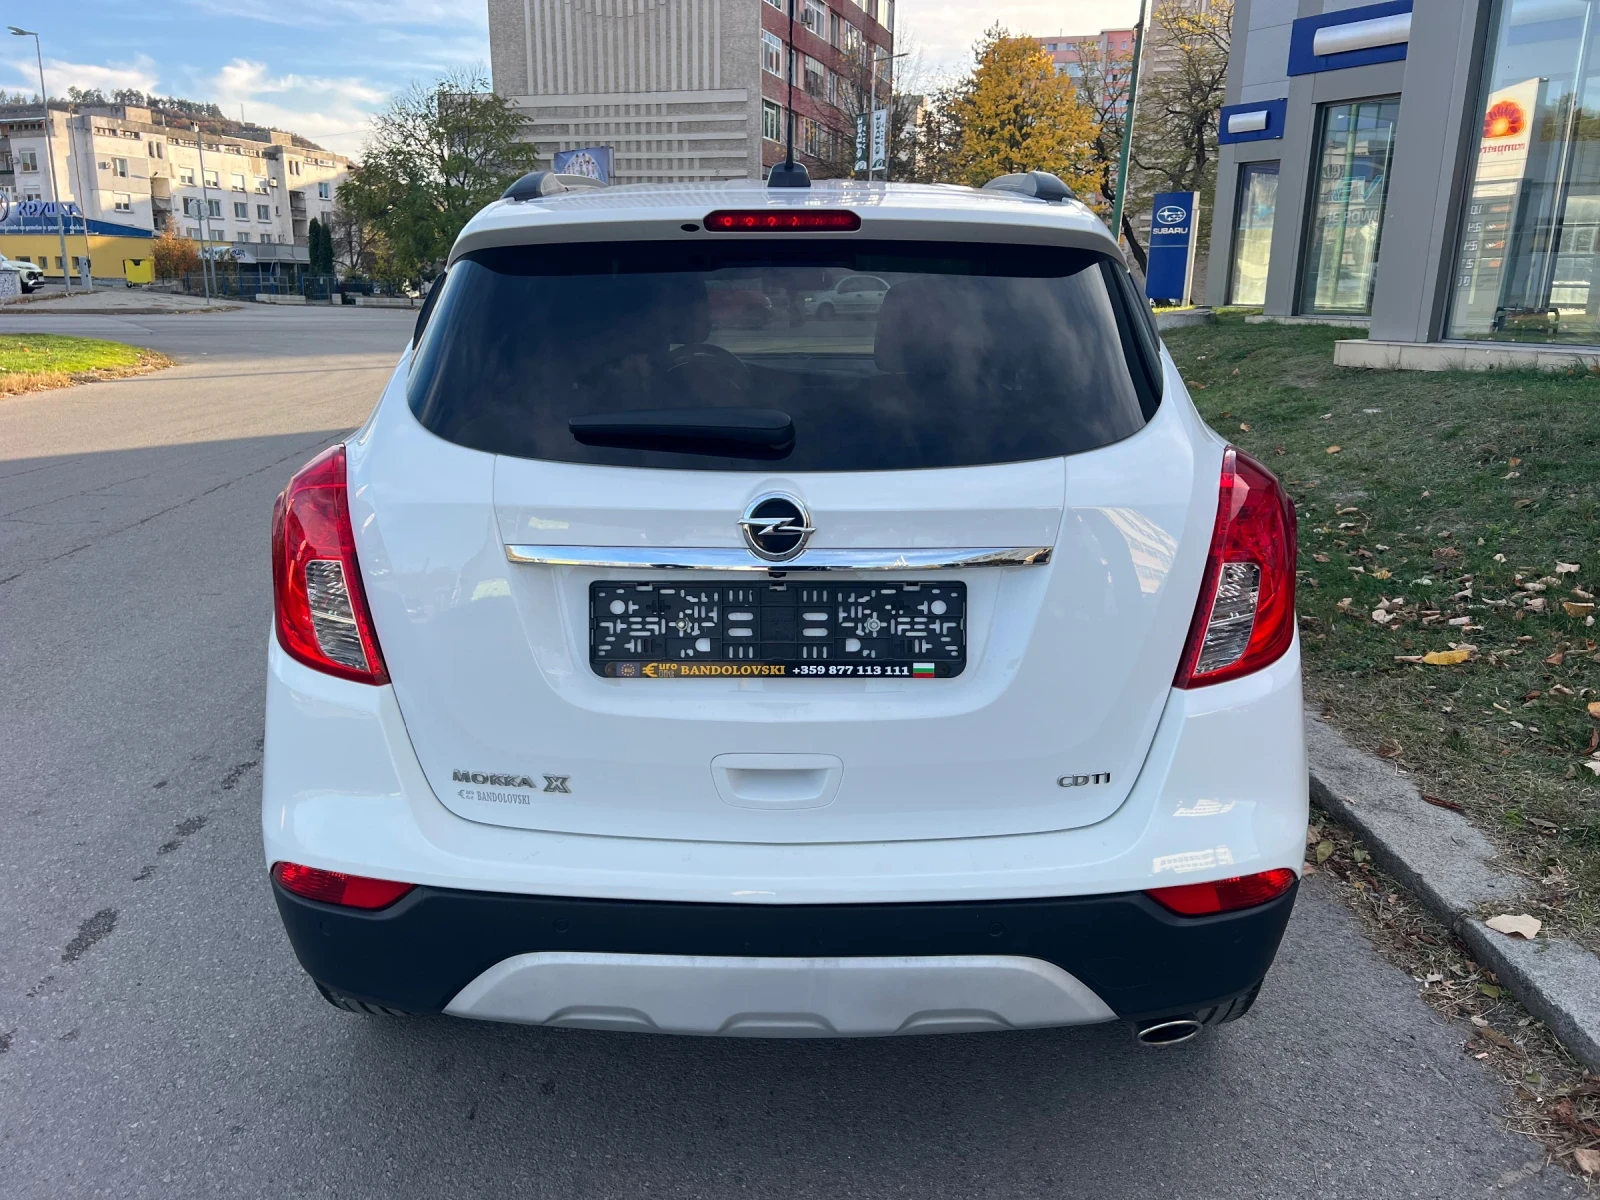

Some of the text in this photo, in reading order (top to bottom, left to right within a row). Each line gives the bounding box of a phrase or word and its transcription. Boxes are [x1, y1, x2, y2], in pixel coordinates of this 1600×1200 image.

[681, 665, 785, 675] BANDOLOVSKI
[792, 665, 825, 675] +359
[829, 665, 853, 675] 877
[857, 665, 882, 675] 113
[885, 666, 910, 675] 111
[452, 769, 572, 794] MOKKA X
[1057, 771, 1111, 788] CDTI
[476, 790, 531, 805] BANDOLOVSKI
